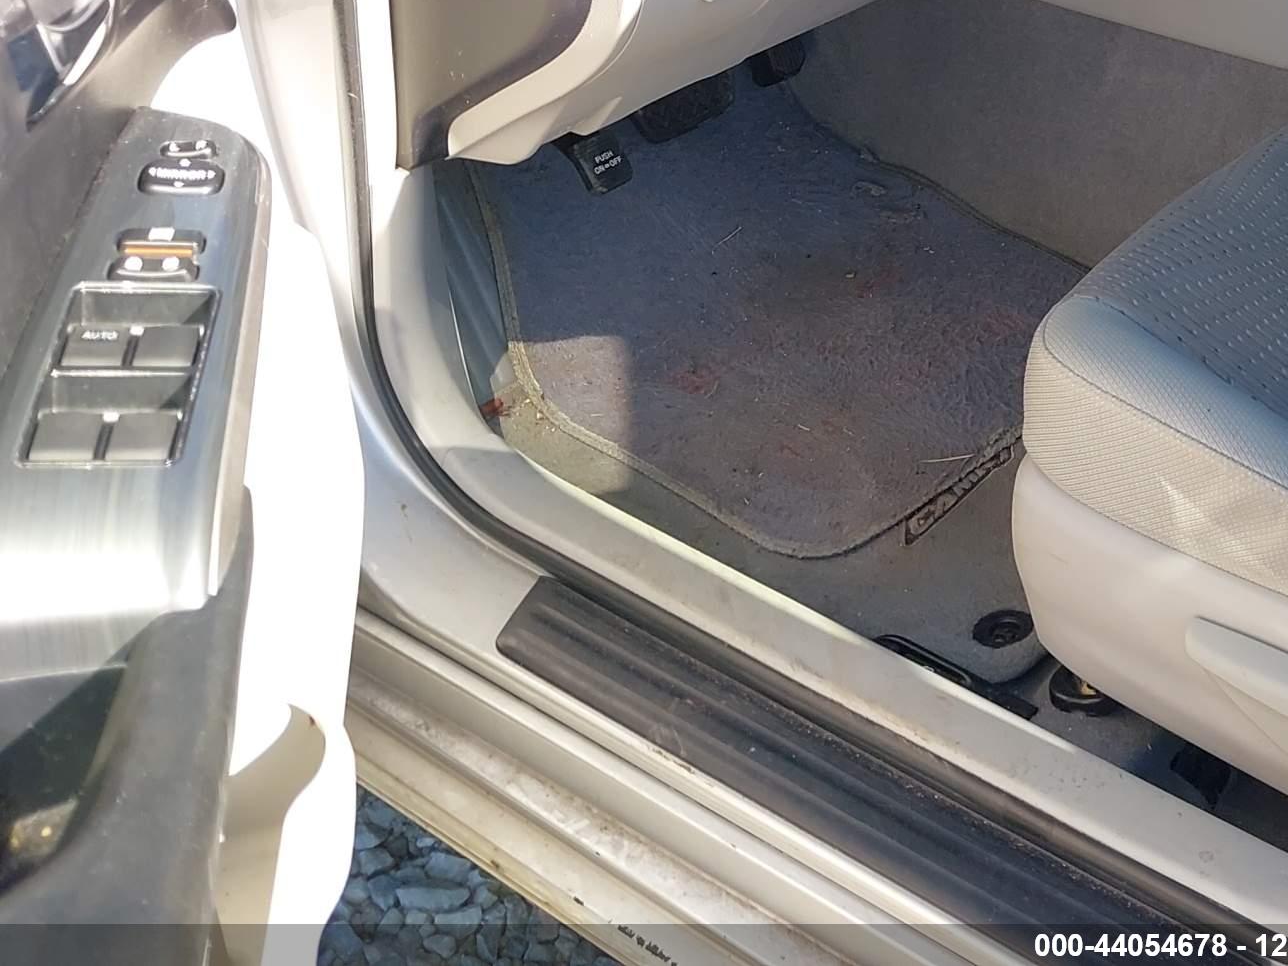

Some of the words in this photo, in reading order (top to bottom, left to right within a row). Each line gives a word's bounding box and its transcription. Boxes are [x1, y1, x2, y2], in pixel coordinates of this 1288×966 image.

[594, 150, 614, 164] PUSH
[609, 155, 622, 167] OFF
[81, 329, 119, 341] AUTO
[908, 447, 1012, 535] CAM
